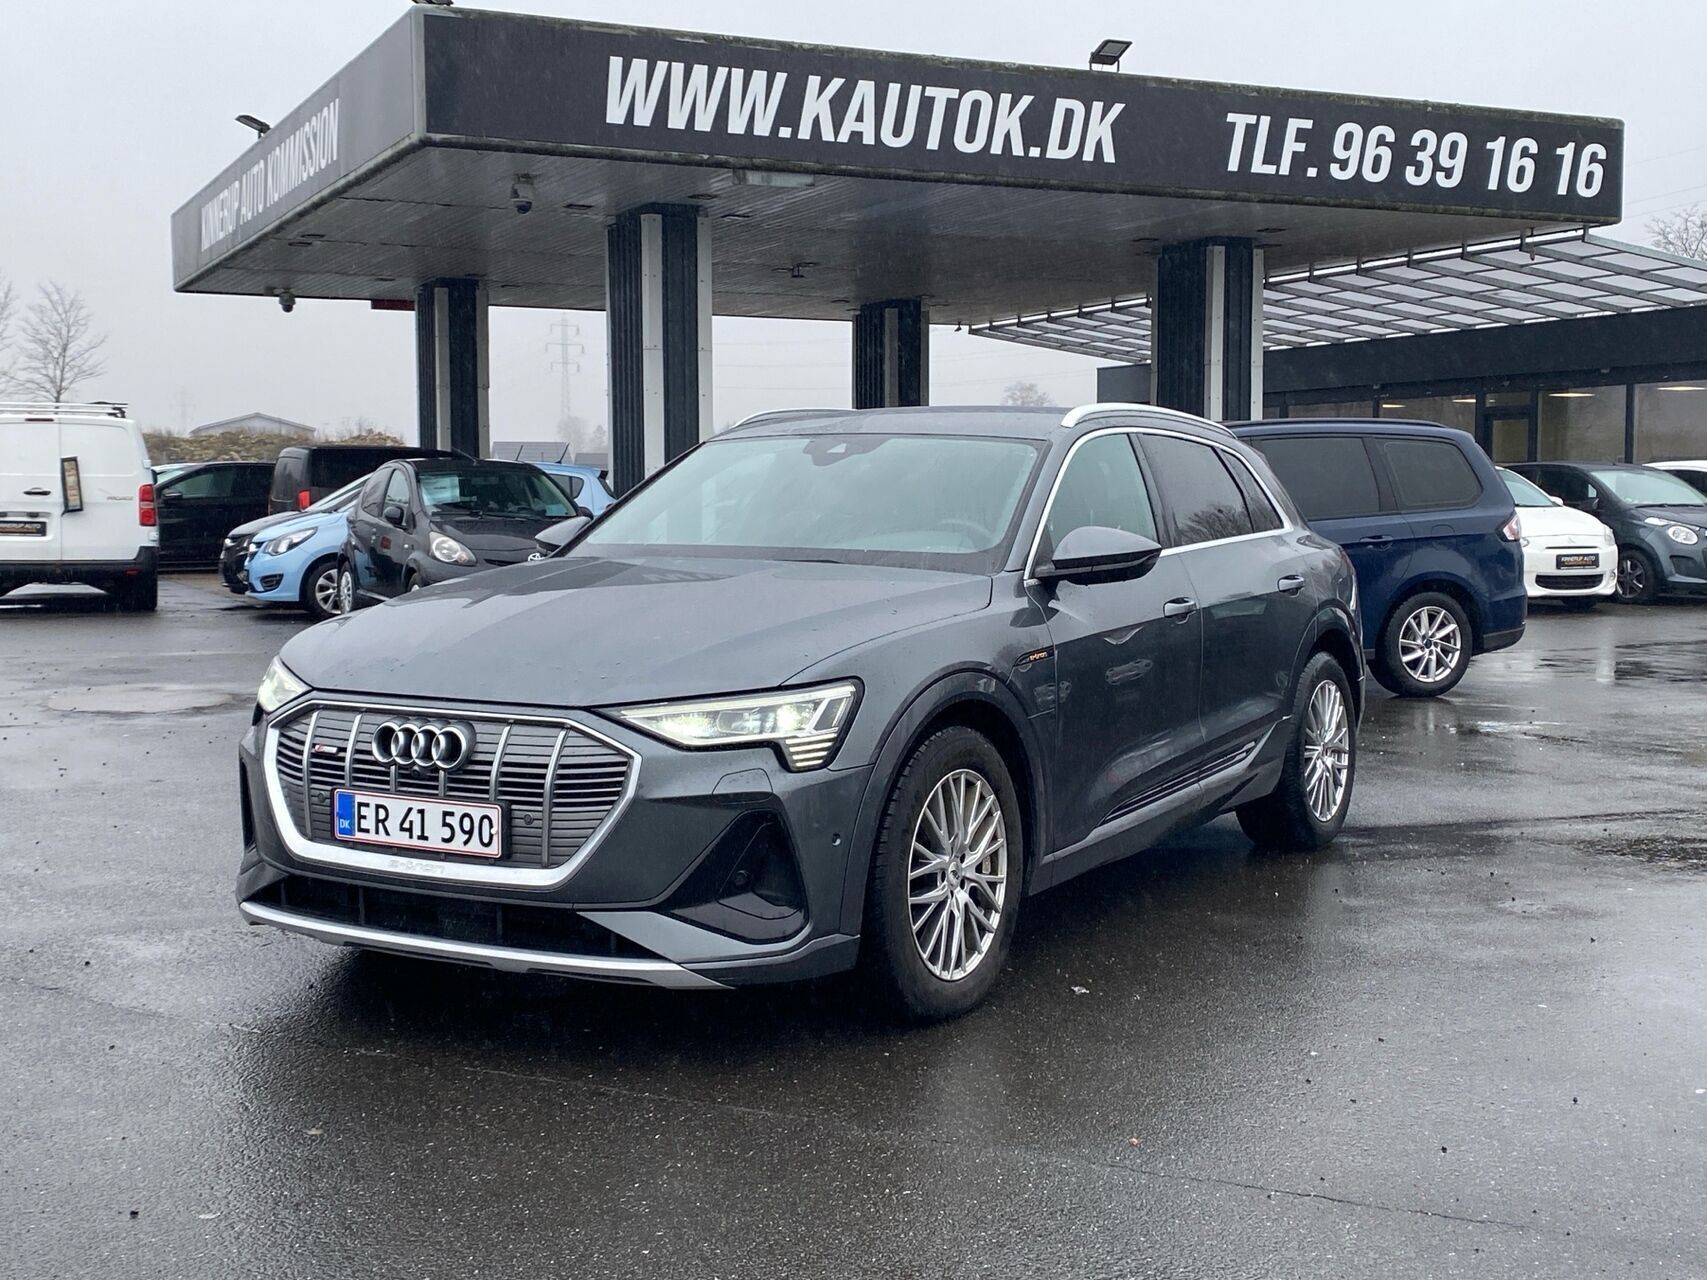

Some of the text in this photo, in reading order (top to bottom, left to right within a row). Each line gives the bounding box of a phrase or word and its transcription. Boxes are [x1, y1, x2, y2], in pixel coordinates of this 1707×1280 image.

[606, 56, 1126, 164] WWW.KAUTOK.DK
[240, 159, 265, 225] AUTO
[266, 98, 340, 208] KOMMISSION
[1226, 112, 1607, 198] TLF. 96 39 16 16
[339, 818, 351, 829] DK
[356, 801, 494, 848] ER 41 590
